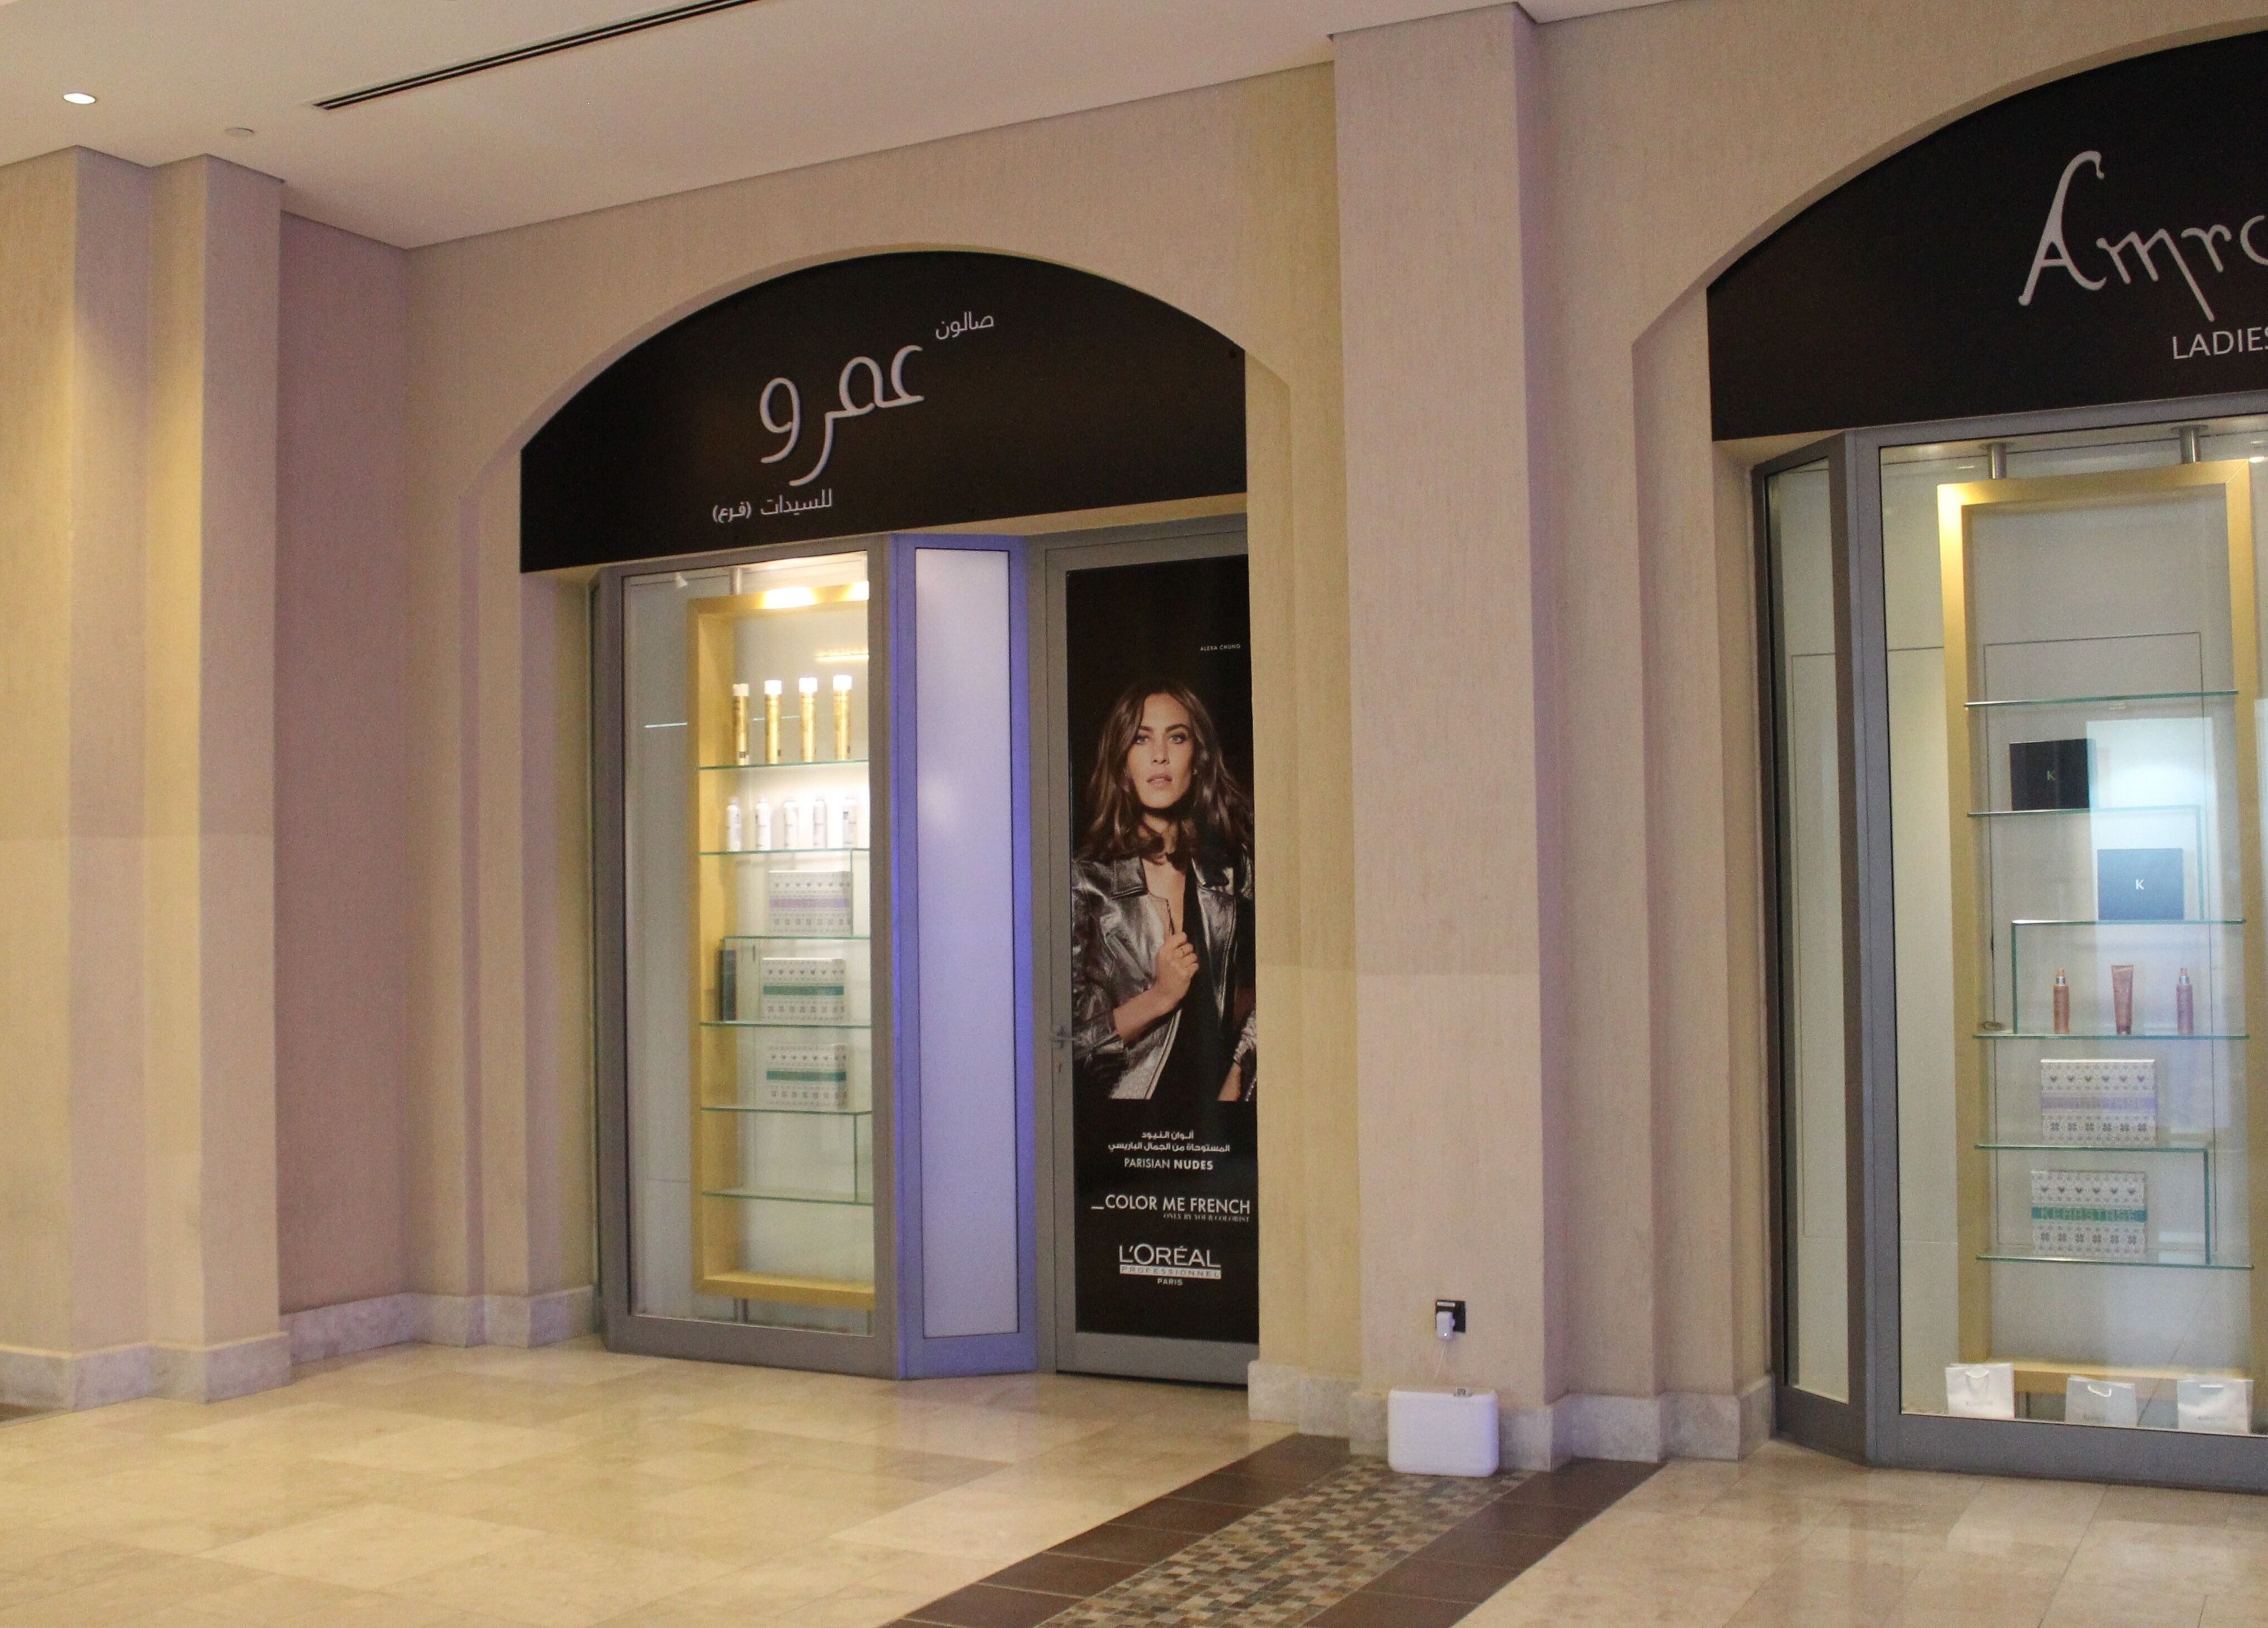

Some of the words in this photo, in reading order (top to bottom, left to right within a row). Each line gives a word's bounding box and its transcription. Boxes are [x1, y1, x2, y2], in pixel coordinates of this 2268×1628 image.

[936, 311, 994, 340] صالون
[759, 344, 925, 486] عمرو
[760, 488, 832, 515] للسيدات
[2136, 879, 2145, 890] K
[1108, 1141, 1142, 1152] الباريسي
[1143, 1142, 1171, 1151] الجمال
[1124, 1158, 1170, 1168] PARISIAN
[1174, 1160, 1213, 1170] NUDES
[1162, 1197, 1185, 1212] ME
[1190, 1198, 1250, 1215] FRENCH
[1119, 1243, 1221, 1268] L'ORÉAL
[1157, 1278, 1184, 1286] PARIS
